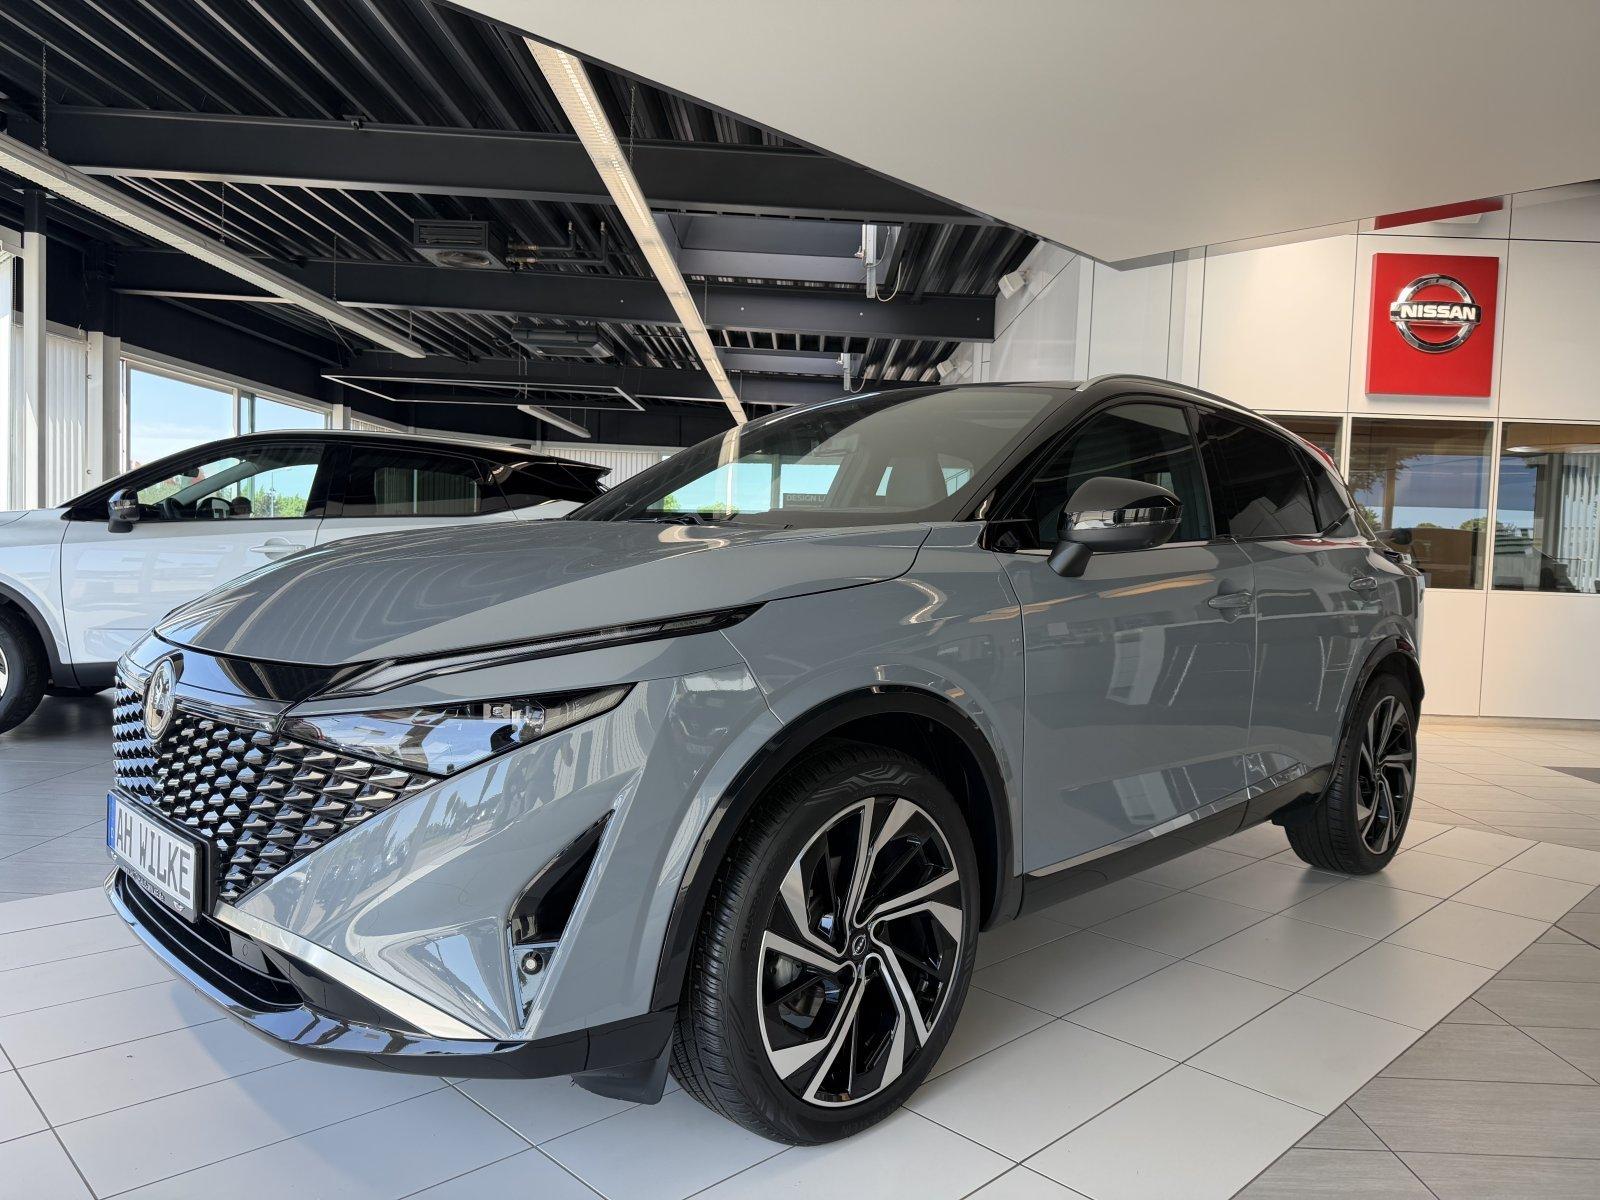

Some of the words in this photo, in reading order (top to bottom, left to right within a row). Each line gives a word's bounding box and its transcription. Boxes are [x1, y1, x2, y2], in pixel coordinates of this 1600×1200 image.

[1400, 305, 1476, 320] NISSAN
[786, 494, 817, 503] DESIGN
[116, 808, 133, 858] AH
[139, 822, 191, 900] WILKE
